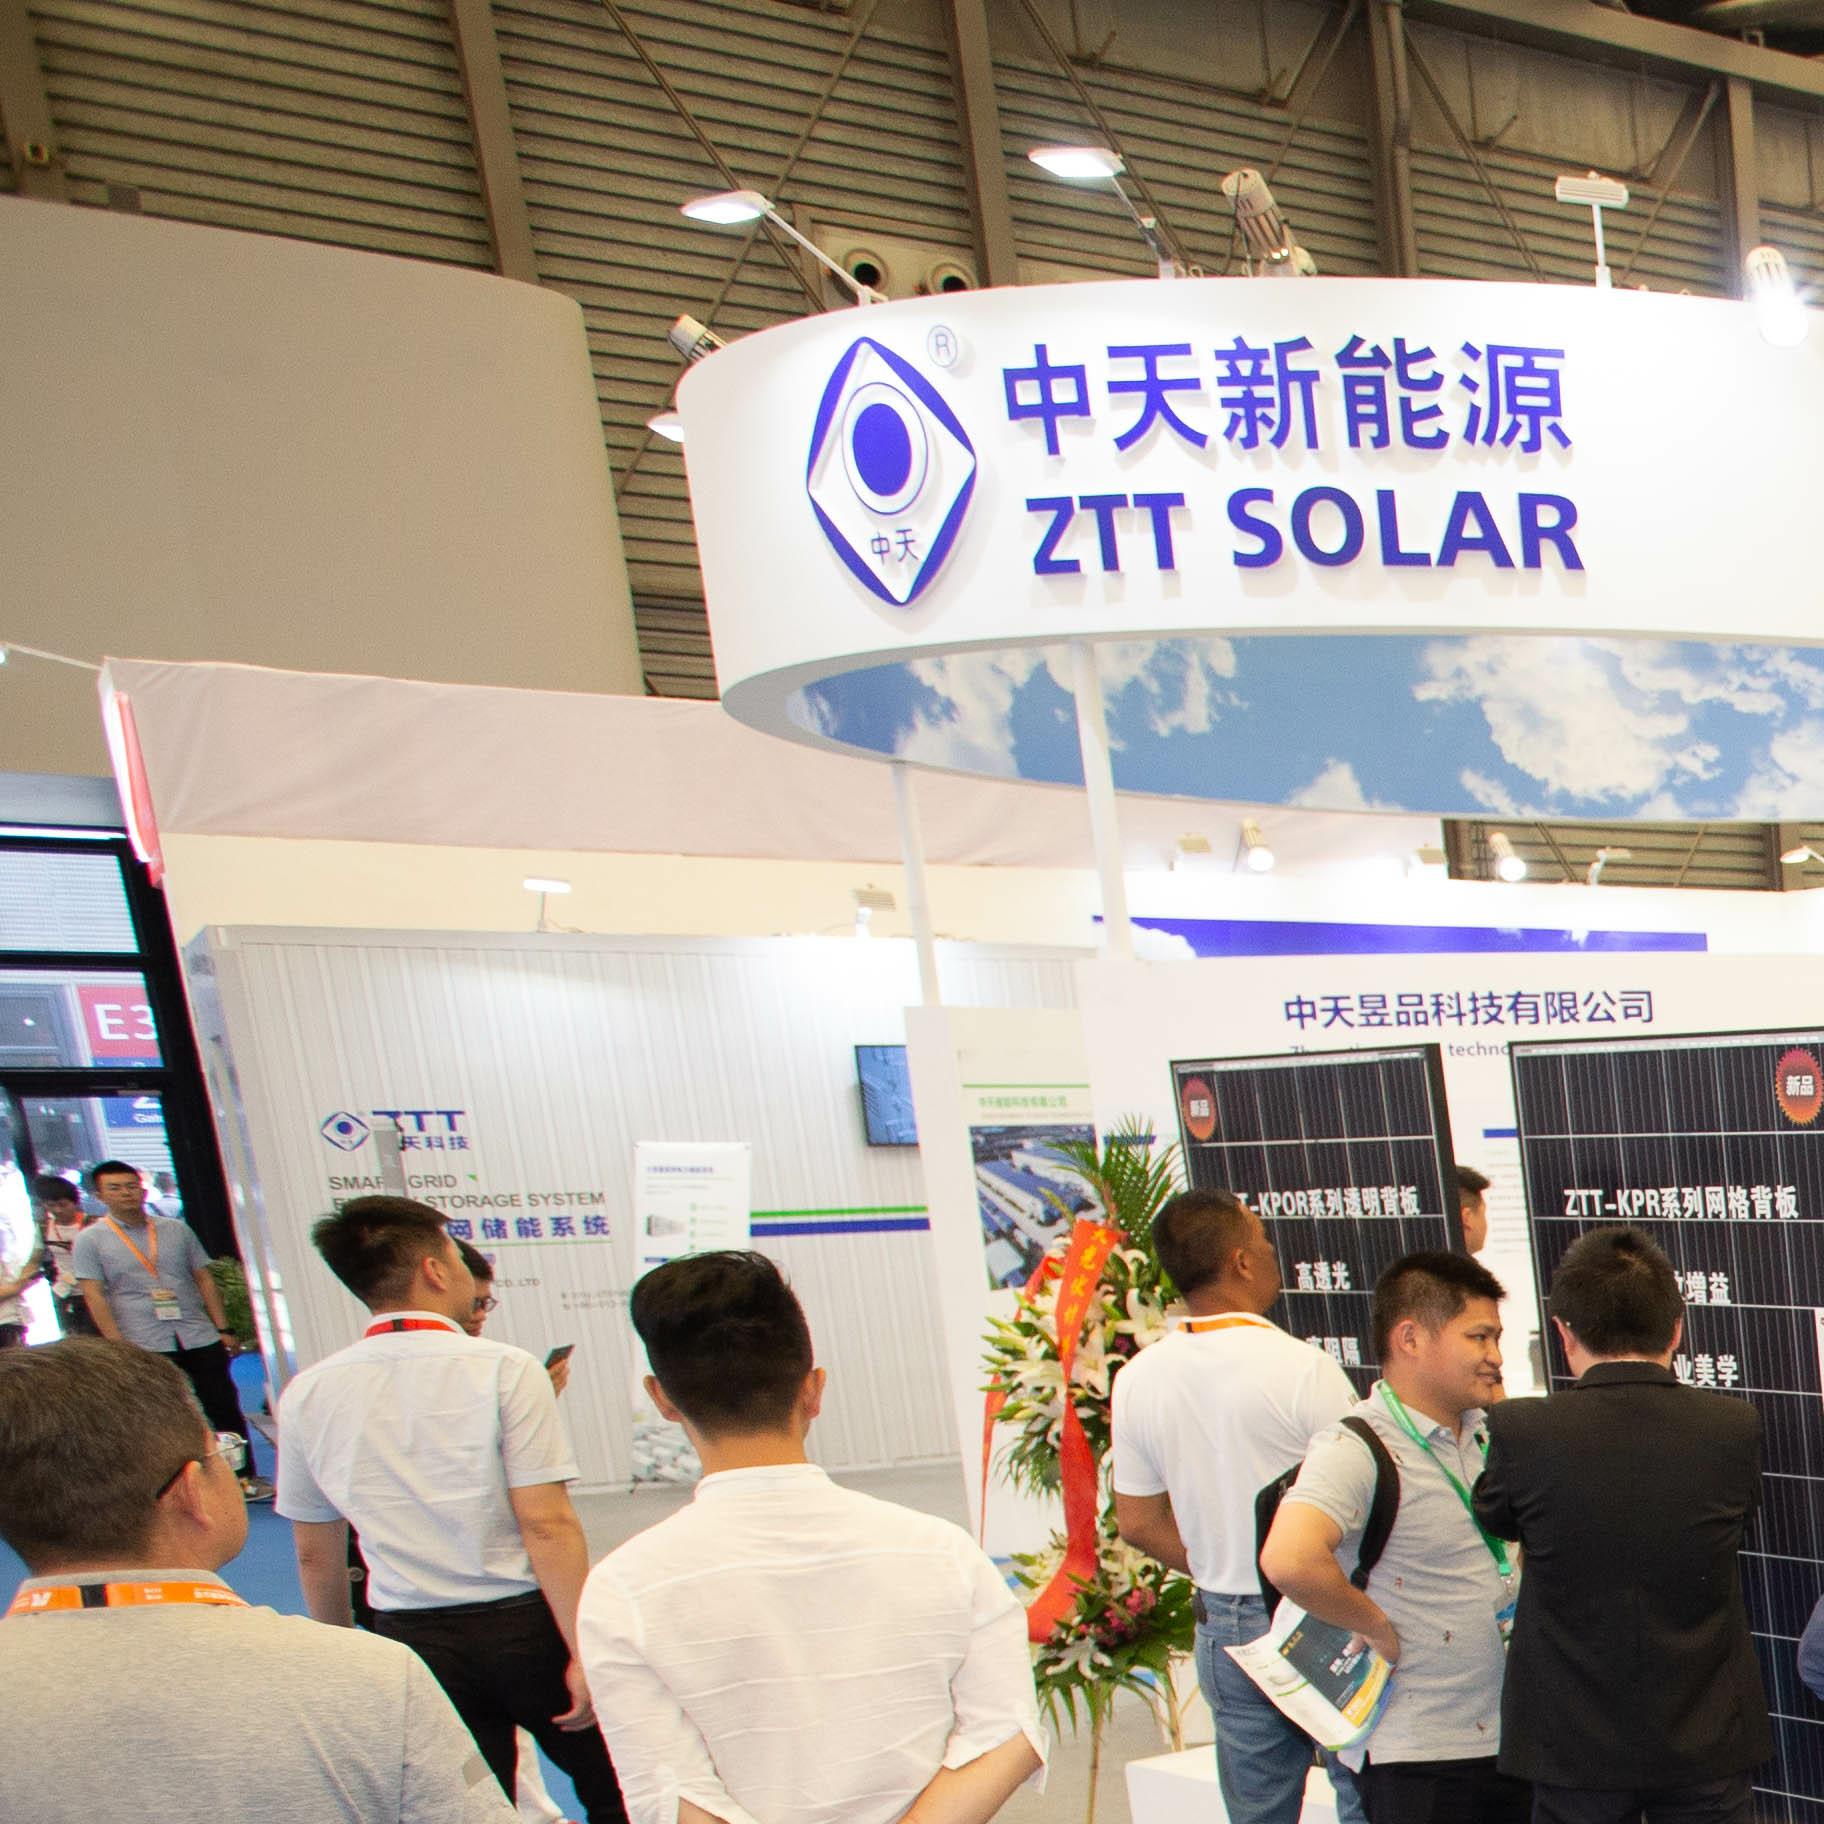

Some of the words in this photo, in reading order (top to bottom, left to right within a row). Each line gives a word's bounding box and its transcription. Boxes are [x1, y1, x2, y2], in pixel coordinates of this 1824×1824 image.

[1002, 335, 1573, 457] 中天新能源
[870, 526, 920, 564] 中天
[1026, 492, 1186, 575] ZTT
[1231, 487, 1585, 572] SOLAR
[1284, 989, 1655, 1031] 中天昱品科技有限公司
[1449, 1041, 1509, 1058] techno
[1785, 1073, 1814, 1097] 新品
[399, 1136, 470, 1151] 天科技
[409, 1175, 458, 1189] GRID
[424, 1194, 523, 1209] STORAGE
[527, 1192, 606, 1207] SYSTEM
[1237, 1185, 1421, 1219] T-KPOR系列透明背板
[1563, 1184, 1800, 1220] ZTT-KPR系列网格背板
[1295, 1261, 1351, 1291] 高透光
[1672, 1354, 1739, 1388] 业美学
